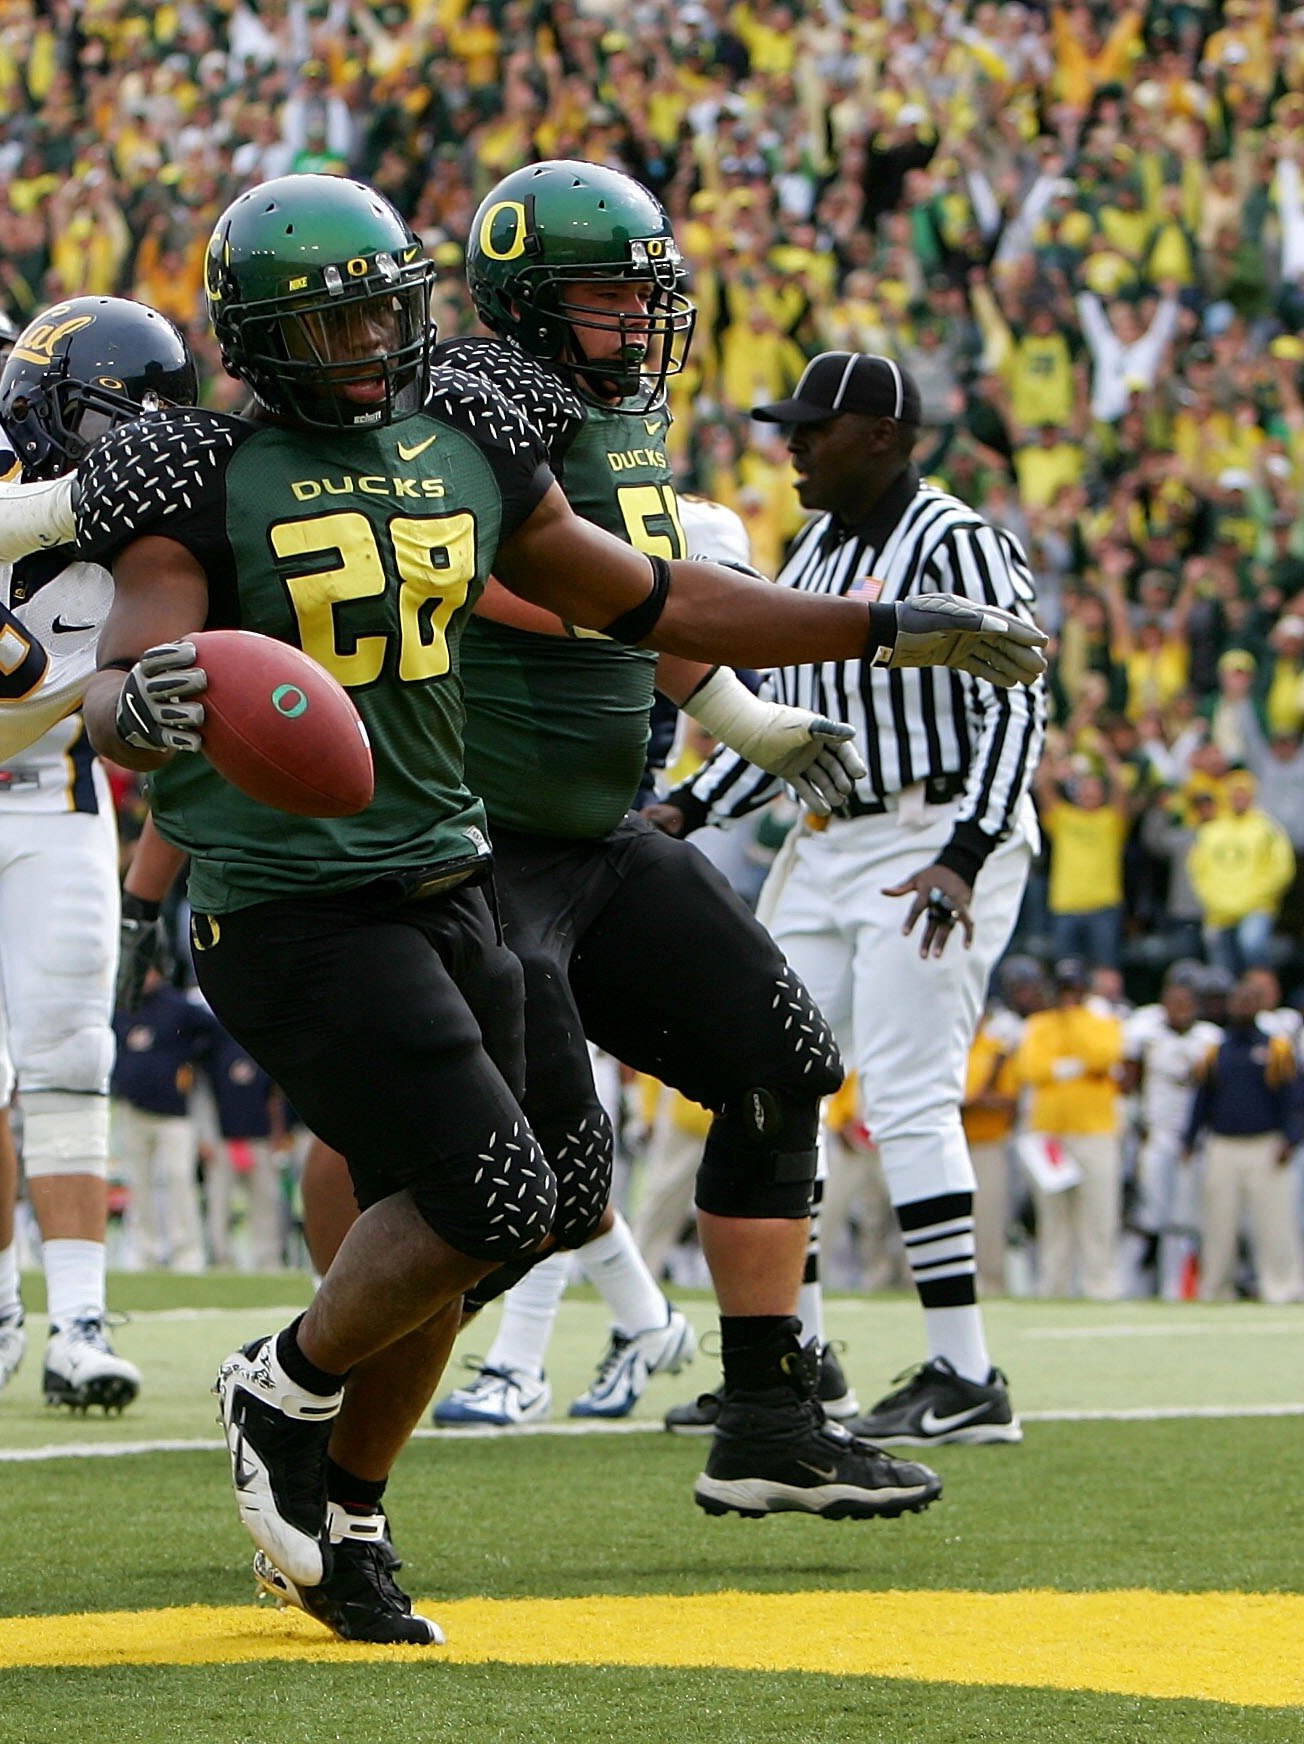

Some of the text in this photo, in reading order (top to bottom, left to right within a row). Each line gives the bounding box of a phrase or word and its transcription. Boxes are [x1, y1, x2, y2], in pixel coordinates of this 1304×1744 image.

[607, 448, 666, 471] DUCKS
[291, 476, 444, 501] DUCKS
[269, 511, 476, 688] 28
